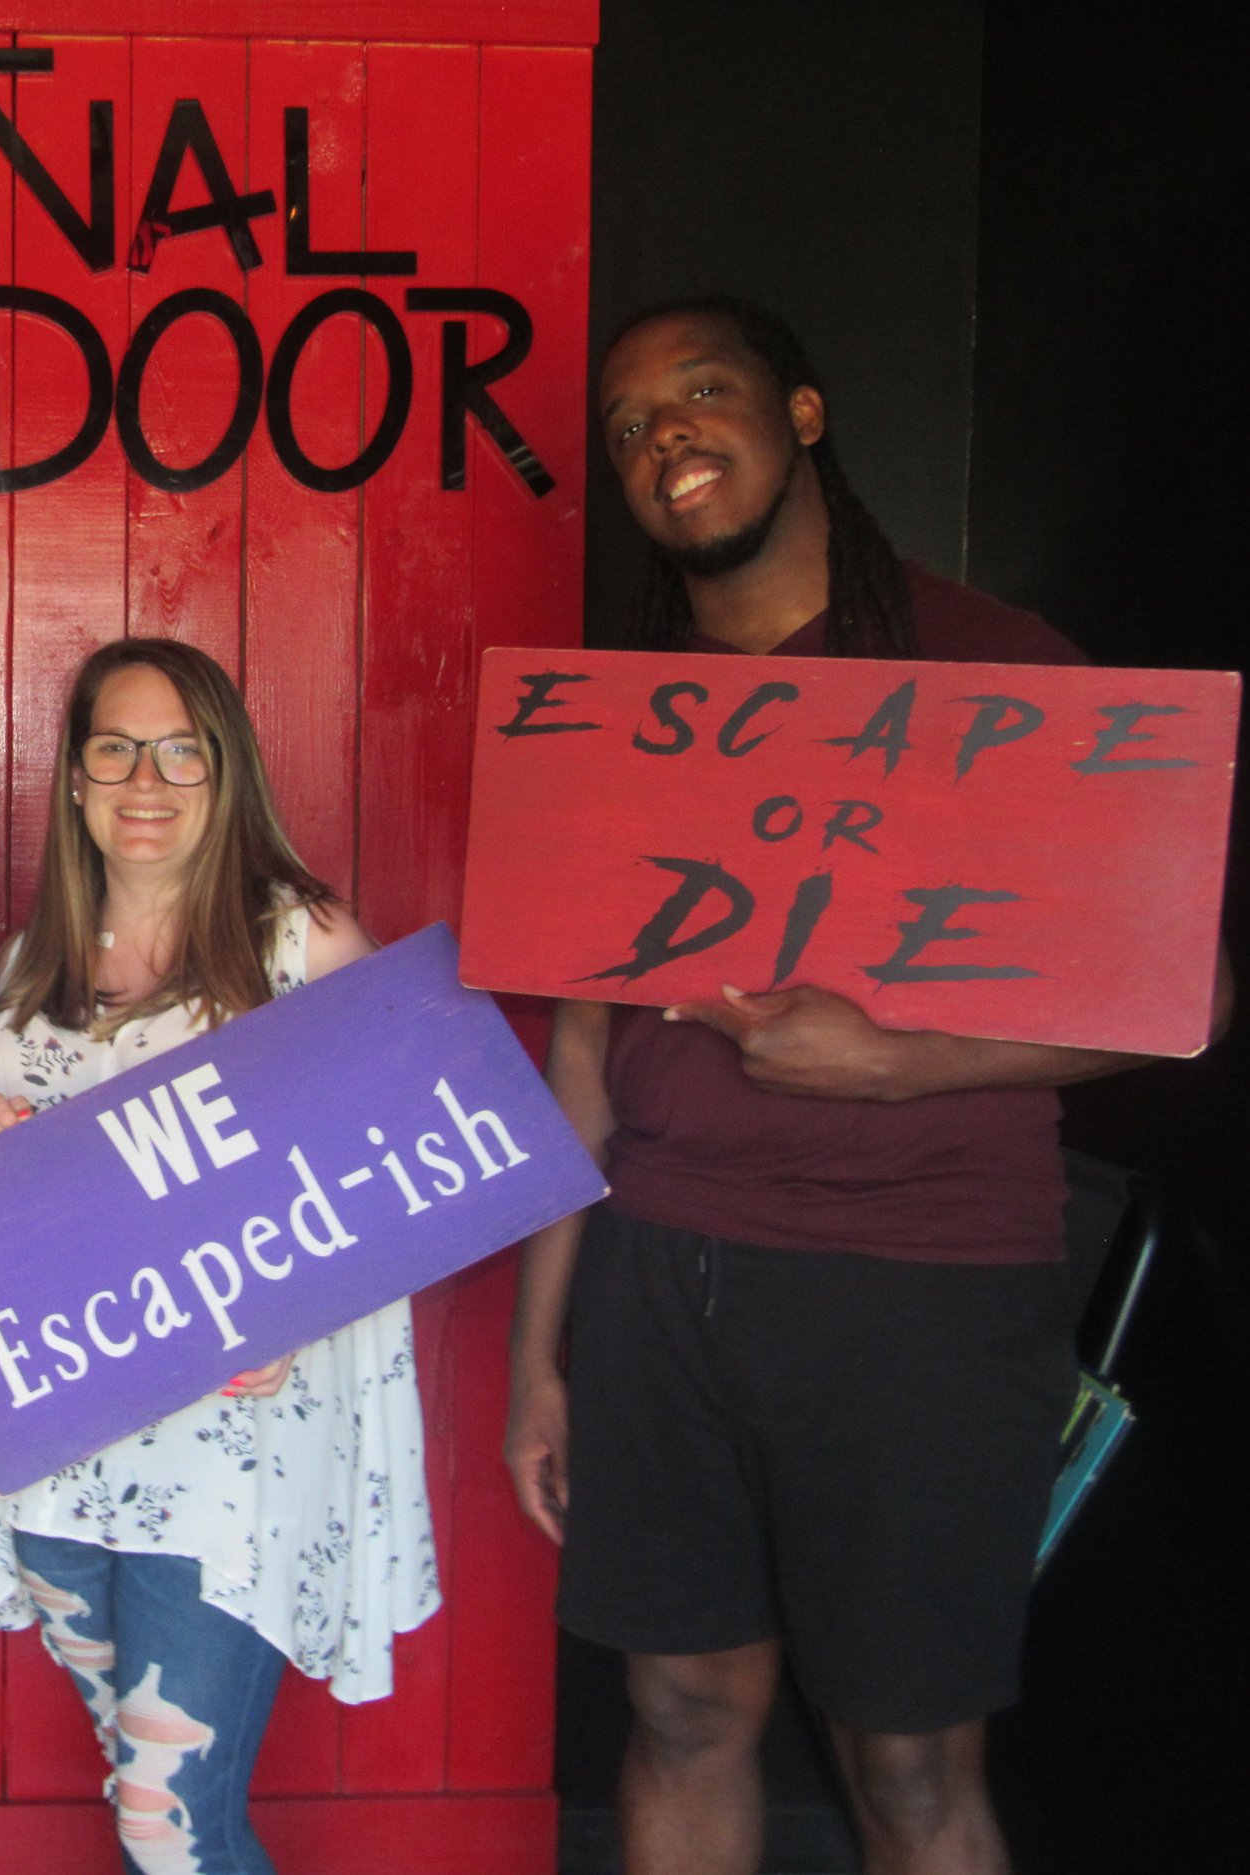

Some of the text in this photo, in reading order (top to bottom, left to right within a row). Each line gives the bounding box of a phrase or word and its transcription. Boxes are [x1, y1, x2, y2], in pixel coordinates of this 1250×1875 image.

[496, 671, 1209, 784] ESCAPE
[753, 795, 884, 855] OR
[565, 854, 1054, 993] DIE
[96, 1062, 259, 1201] WE
